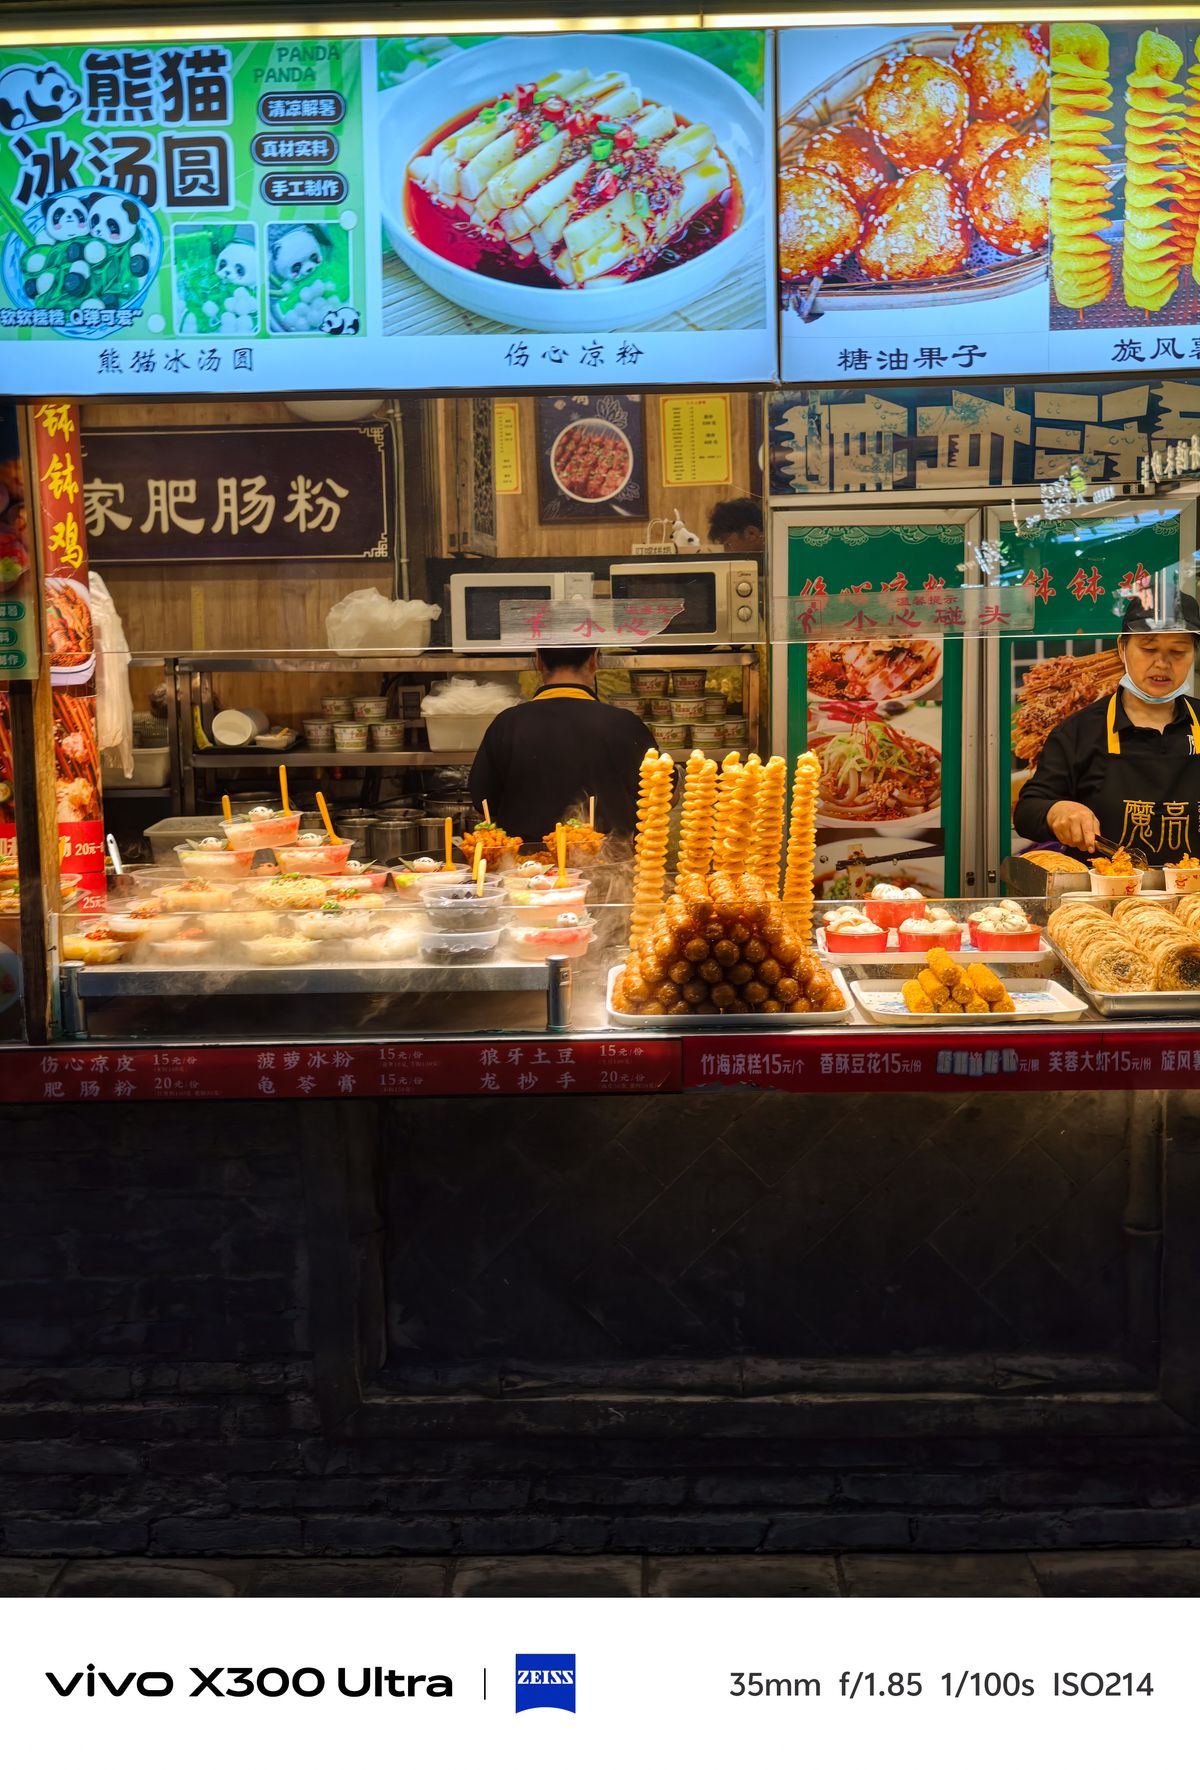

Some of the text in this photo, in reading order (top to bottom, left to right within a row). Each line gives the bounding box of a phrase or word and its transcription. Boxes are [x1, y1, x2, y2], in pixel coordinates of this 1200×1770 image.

[277, 45, 340, 62] PANDA
[84, 49, 229, 122] 熊猫
[253, 67, 316, 83] PANDA
[267, 99, 337, 117] 清凉解暑
[262, 140, 329, 157] 真材实料
[14, 135, 229, 208] 冰汤圆
[271, 180, 339, 197] 手工制作
[97, 347, 254, 374] 熊猫冰汤圆
[504, 339, 644, 367] 伤心凉粉
[837, 345, 988, 371] 糖油果子
[83, 474, 350, 537] 家肥肠粉
[843, 605, 1012, 631] 小心碰头
[40, 1053, 198, 1074] 伤心凉皮 15元/份
[257, 1047, 424, 1070] 菠萝冰粉 15元/份
[480, 1044, 644, 1066] 狼牙土豆 15元/份
[701, 1053, 805, 1075] 竹海凉糕15元/个
[820, 1053, 922, 1074] 香酥豆花15元/份
[1048, 1050, 1152, 1072] 芙蓉大虾15元/份
[43, 1077, 137, 1097] 肥肠粉
[258, 1074, 356, 1094] 龟苓膏
[480, 1071, 576, 1091] 龙抄手
